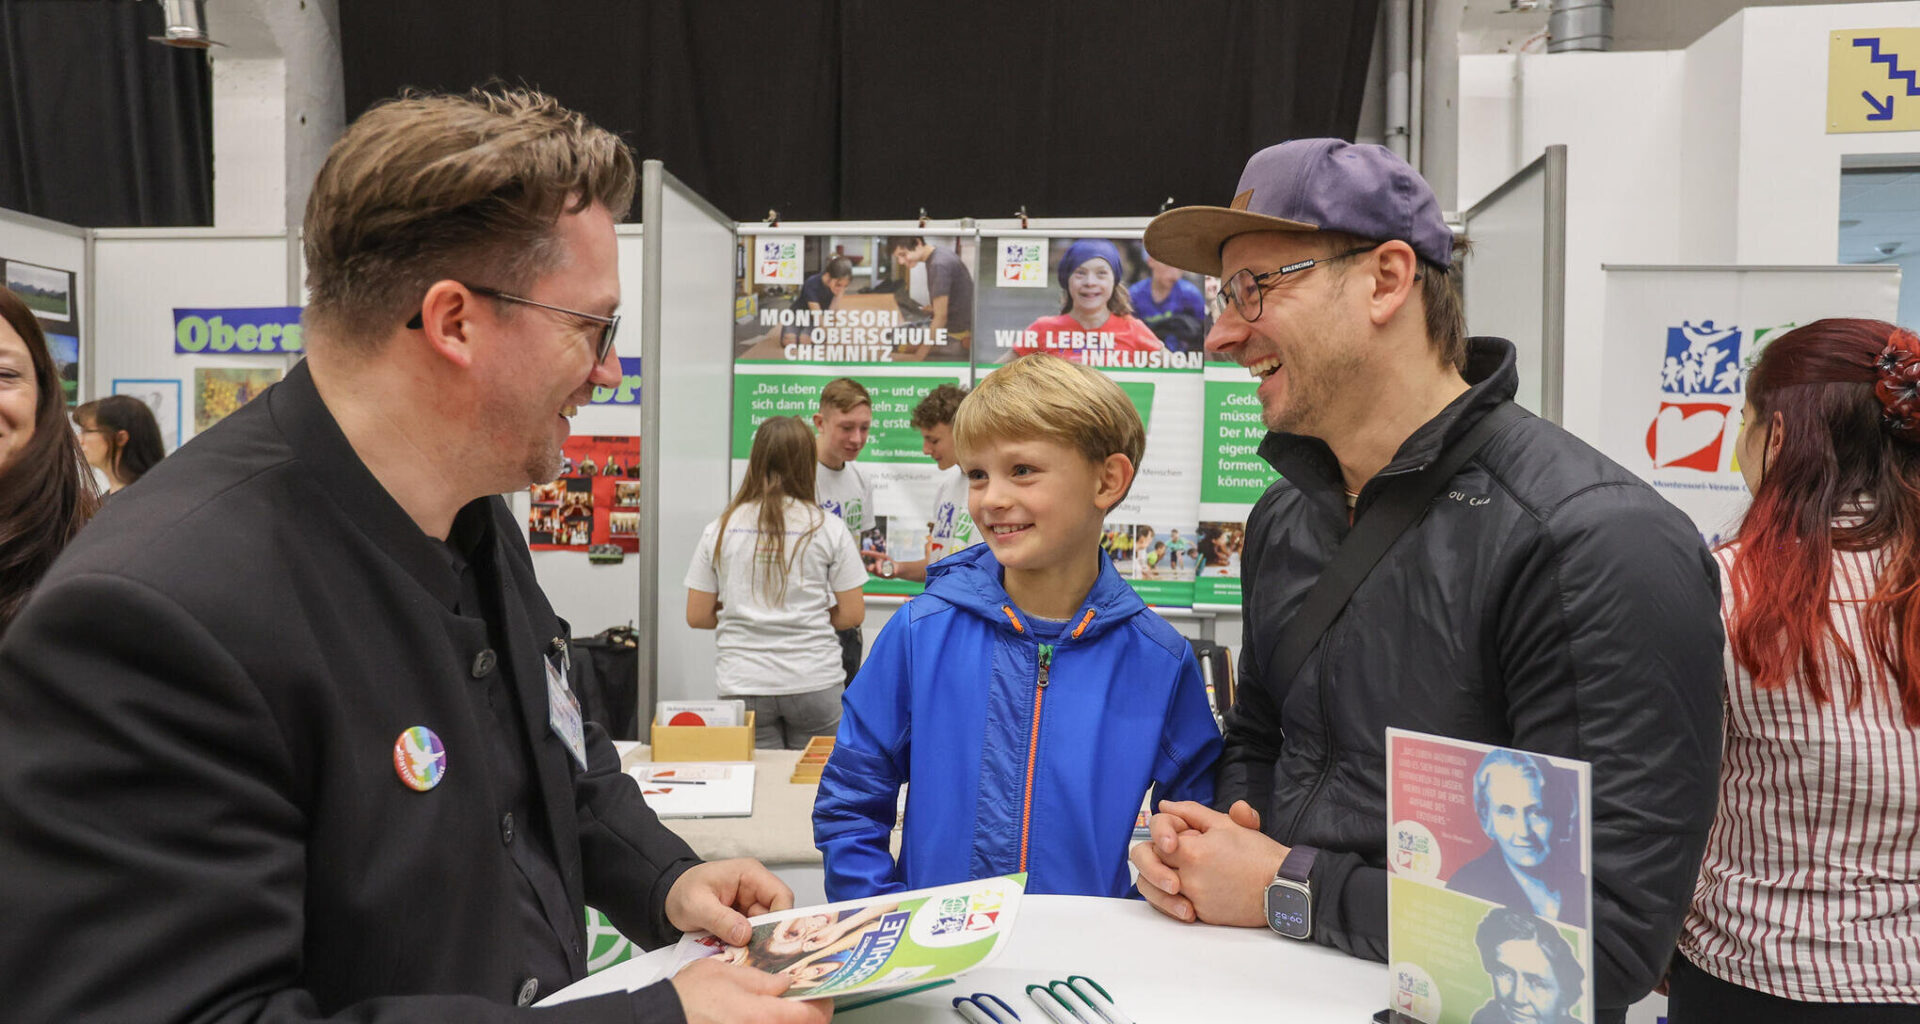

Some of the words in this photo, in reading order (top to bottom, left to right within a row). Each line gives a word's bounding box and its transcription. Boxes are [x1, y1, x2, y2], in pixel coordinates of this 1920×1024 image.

[760, 309, 899, 327] MONTESSORI
[811, 327, 948, 346] OBERSCHULE
[995, 330, 1038, 348] WIR
[1045, 331, 1115, 349] LEBEN
[784, 344, 893, 362] CHEMNITZ
[1081, 350, 1204, 369] INKLUSION
[782, 384, 816, 395] Leben
[892, 386, 914, 396] und
[752, 398, 774, 410] sich
[776, 399, 805, 410] dann
[894, 404, 909, 413] zu
[1220, 427, 1241, 438] Der
[1218, 458, 1266, 473] formen,
